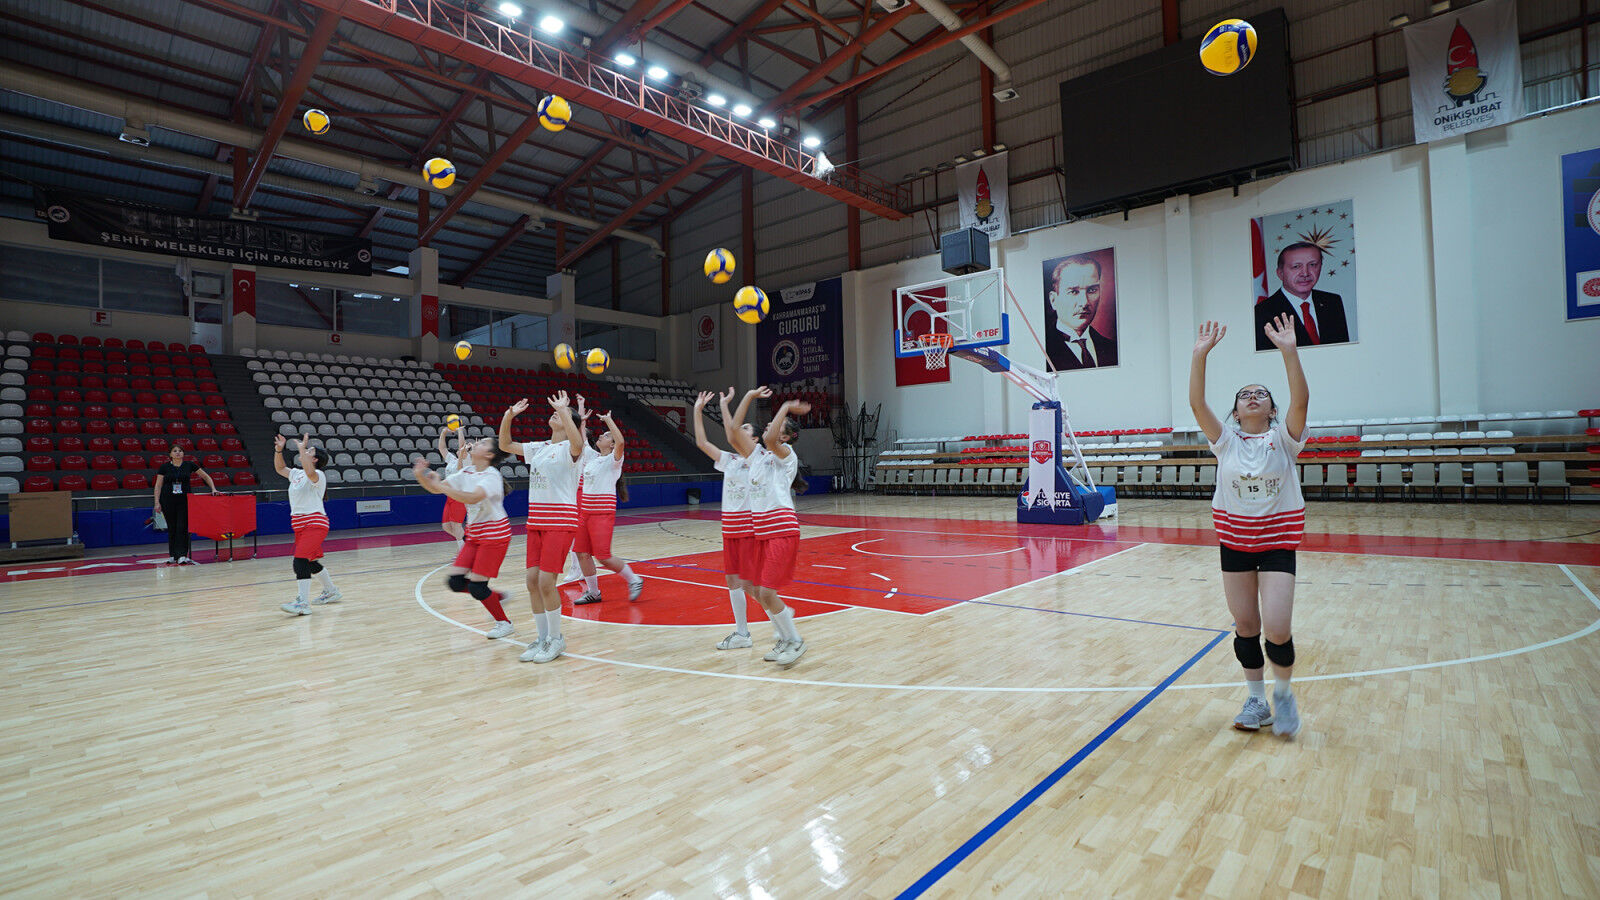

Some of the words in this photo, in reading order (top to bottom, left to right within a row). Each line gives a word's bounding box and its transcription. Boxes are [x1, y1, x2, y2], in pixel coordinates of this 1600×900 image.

[1434, 101, 1502, 126] ONİKİŞUBAT
[1443, 112, 1495, 131] BELEDİYESİ
[101, 231, 150, 247] ŞEHİT
[155, 239, 235, 257] MELEKLER
[240, 248, 269, 261] İÇİN
[273, 254, 350, 270] PARKEDEYİZ
[96, 311, 106, 323] F
[779, 314, 820, 336] GURURU
[331, 333, 341, 343] G
[983, 328, 1000, 338] TBF
[1247, 485, 1260, 493] 15
